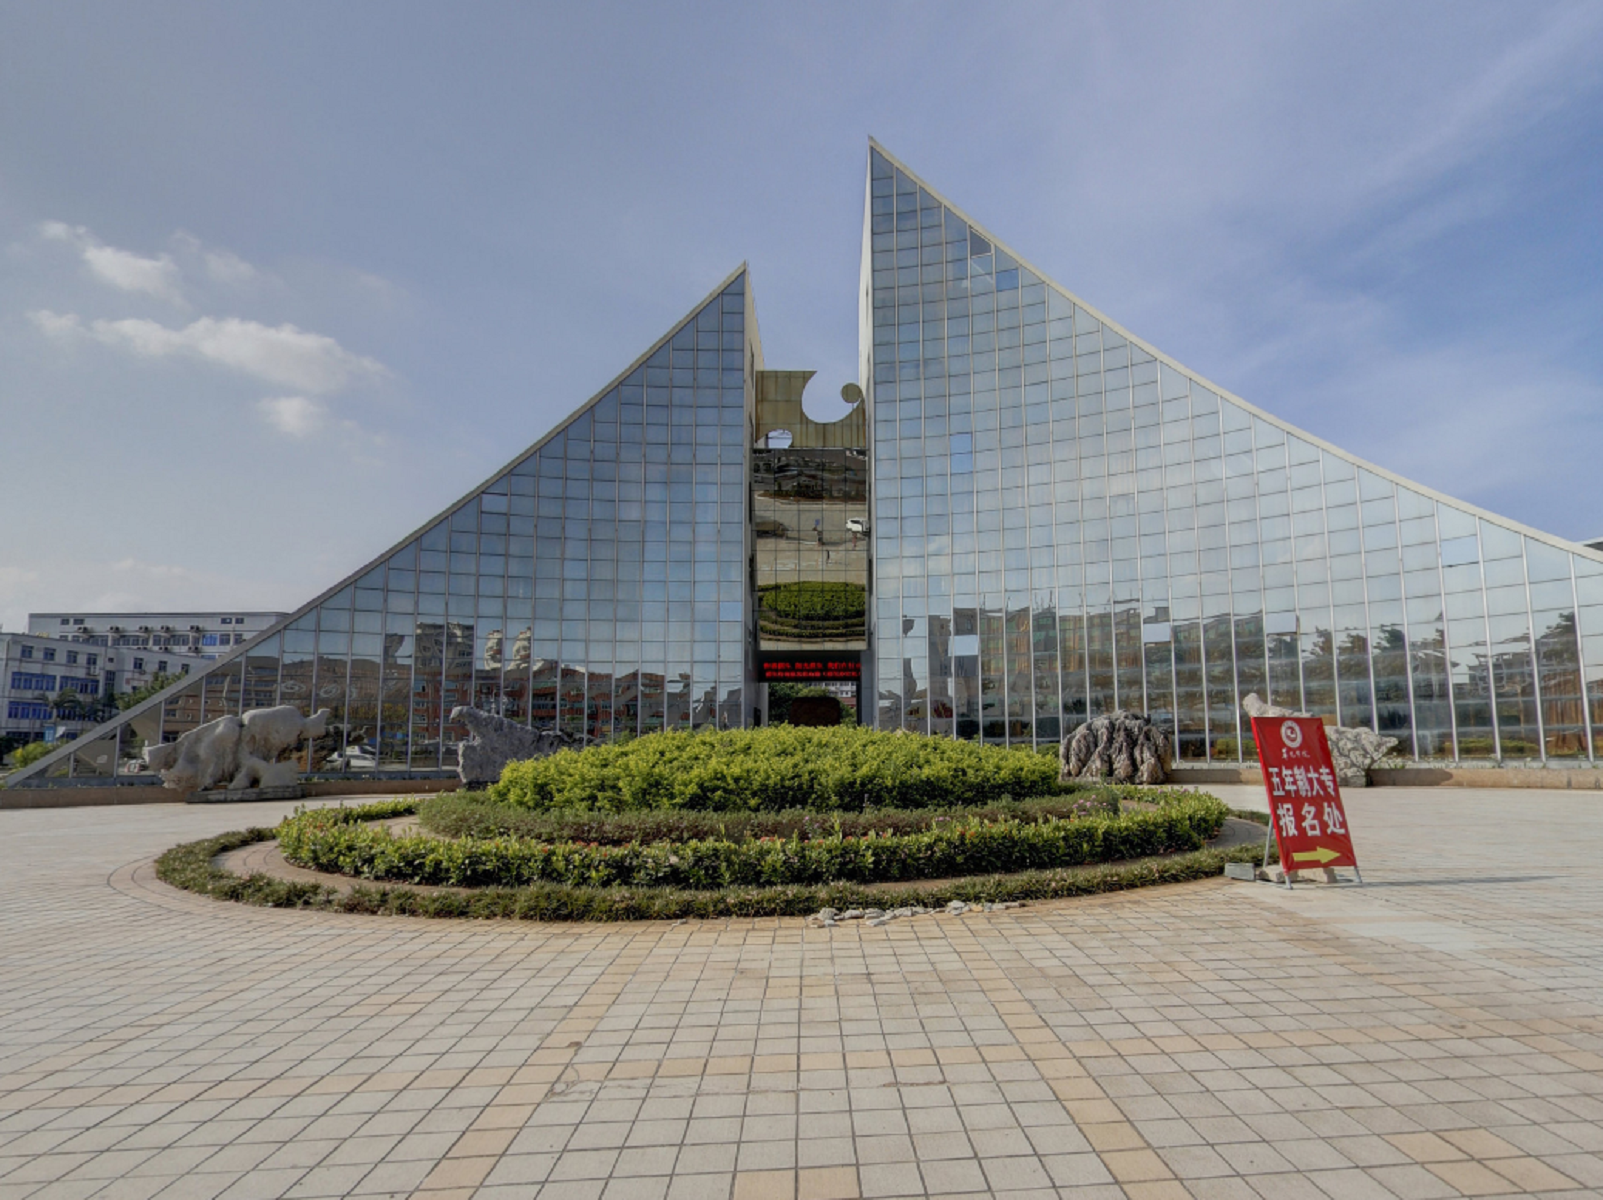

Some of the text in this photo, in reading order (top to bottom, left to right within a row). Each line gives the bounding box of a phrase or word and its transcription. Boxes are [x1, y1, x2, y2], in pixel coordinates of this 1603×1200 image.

[1268, 764, 1336, 797] 五年制大专
[1277, 802, 1346, 837] 报名处
